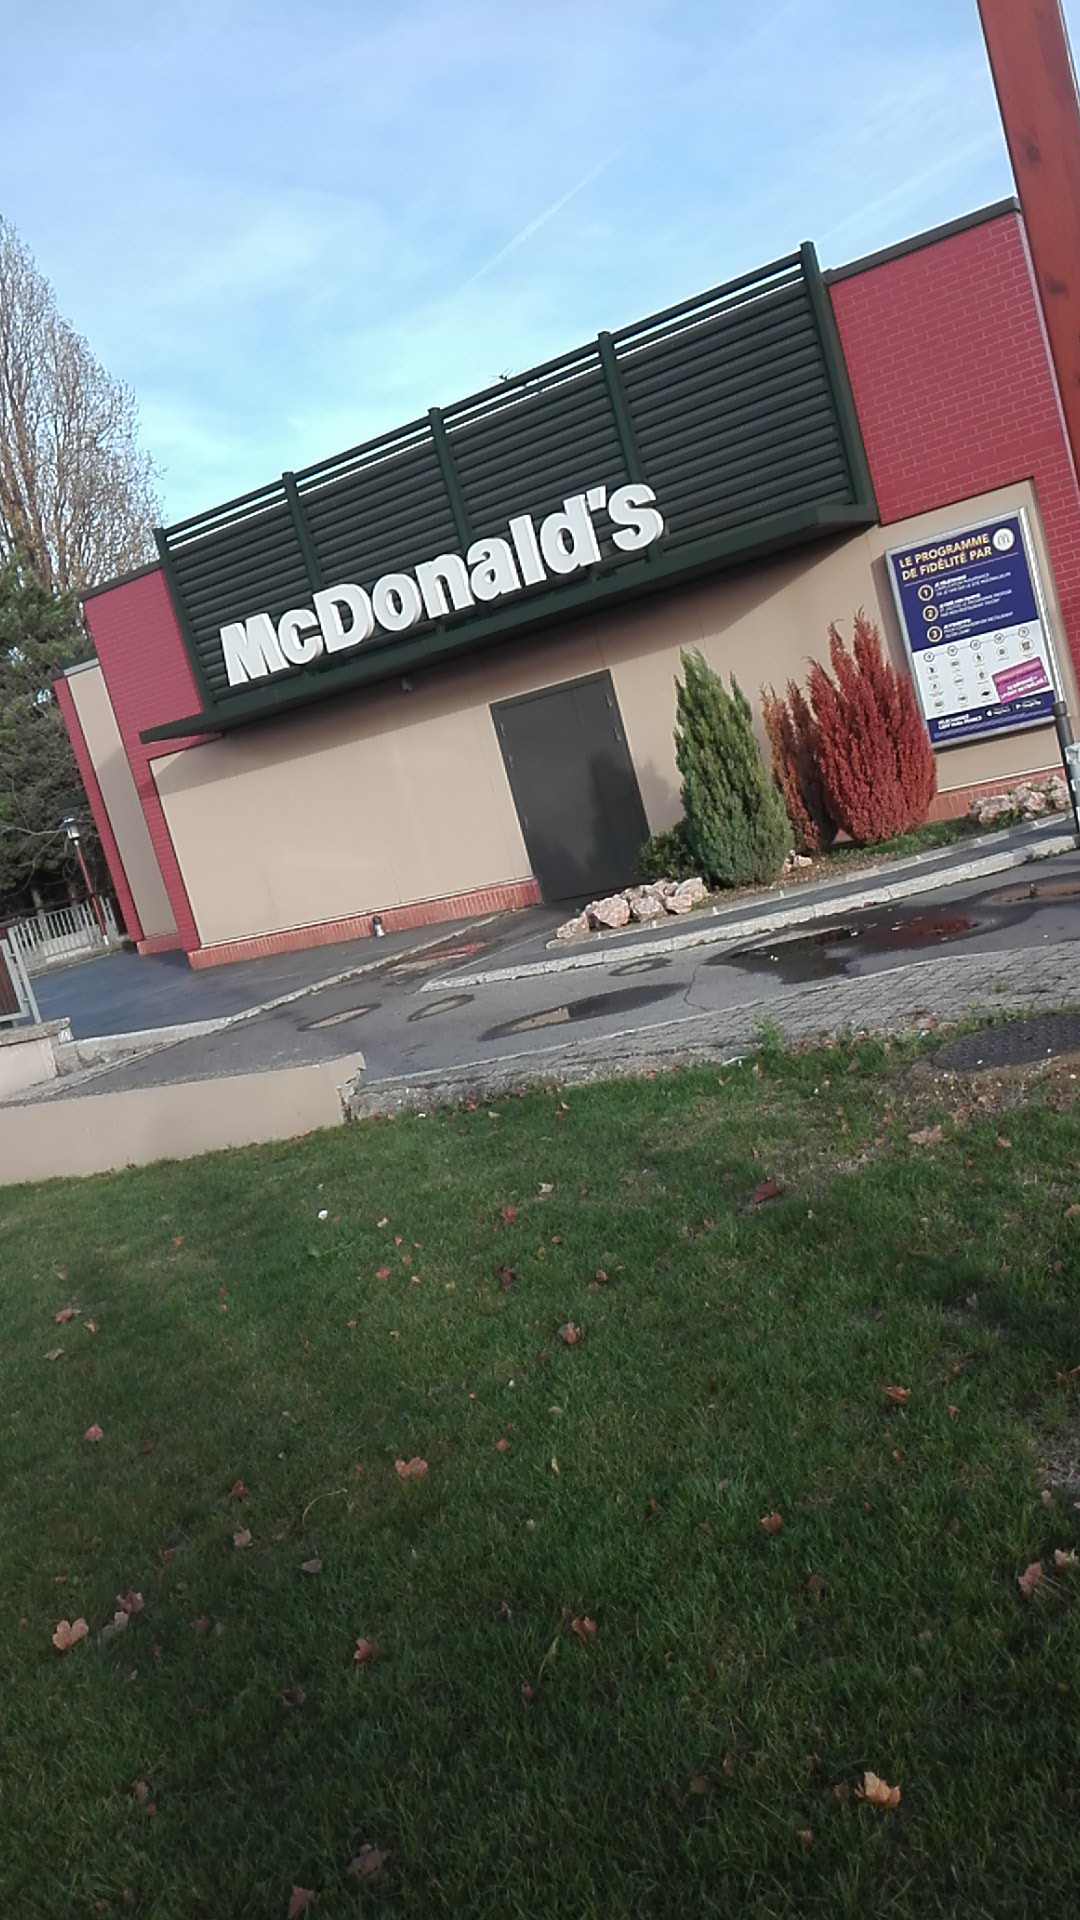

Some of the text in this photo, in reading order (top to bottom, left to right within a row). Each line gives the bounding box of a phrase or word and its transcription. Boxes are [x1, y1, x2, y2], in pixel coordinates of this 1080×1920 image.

[899, 533, 990, 569] LE PROGRAMME
[902, 568, 919, 581] DE
[920, 552, 968, 576] FIDÉLITÉ
[969, 546, 992, 561] PAR
[219, 483, 664, 687] McDonald's
